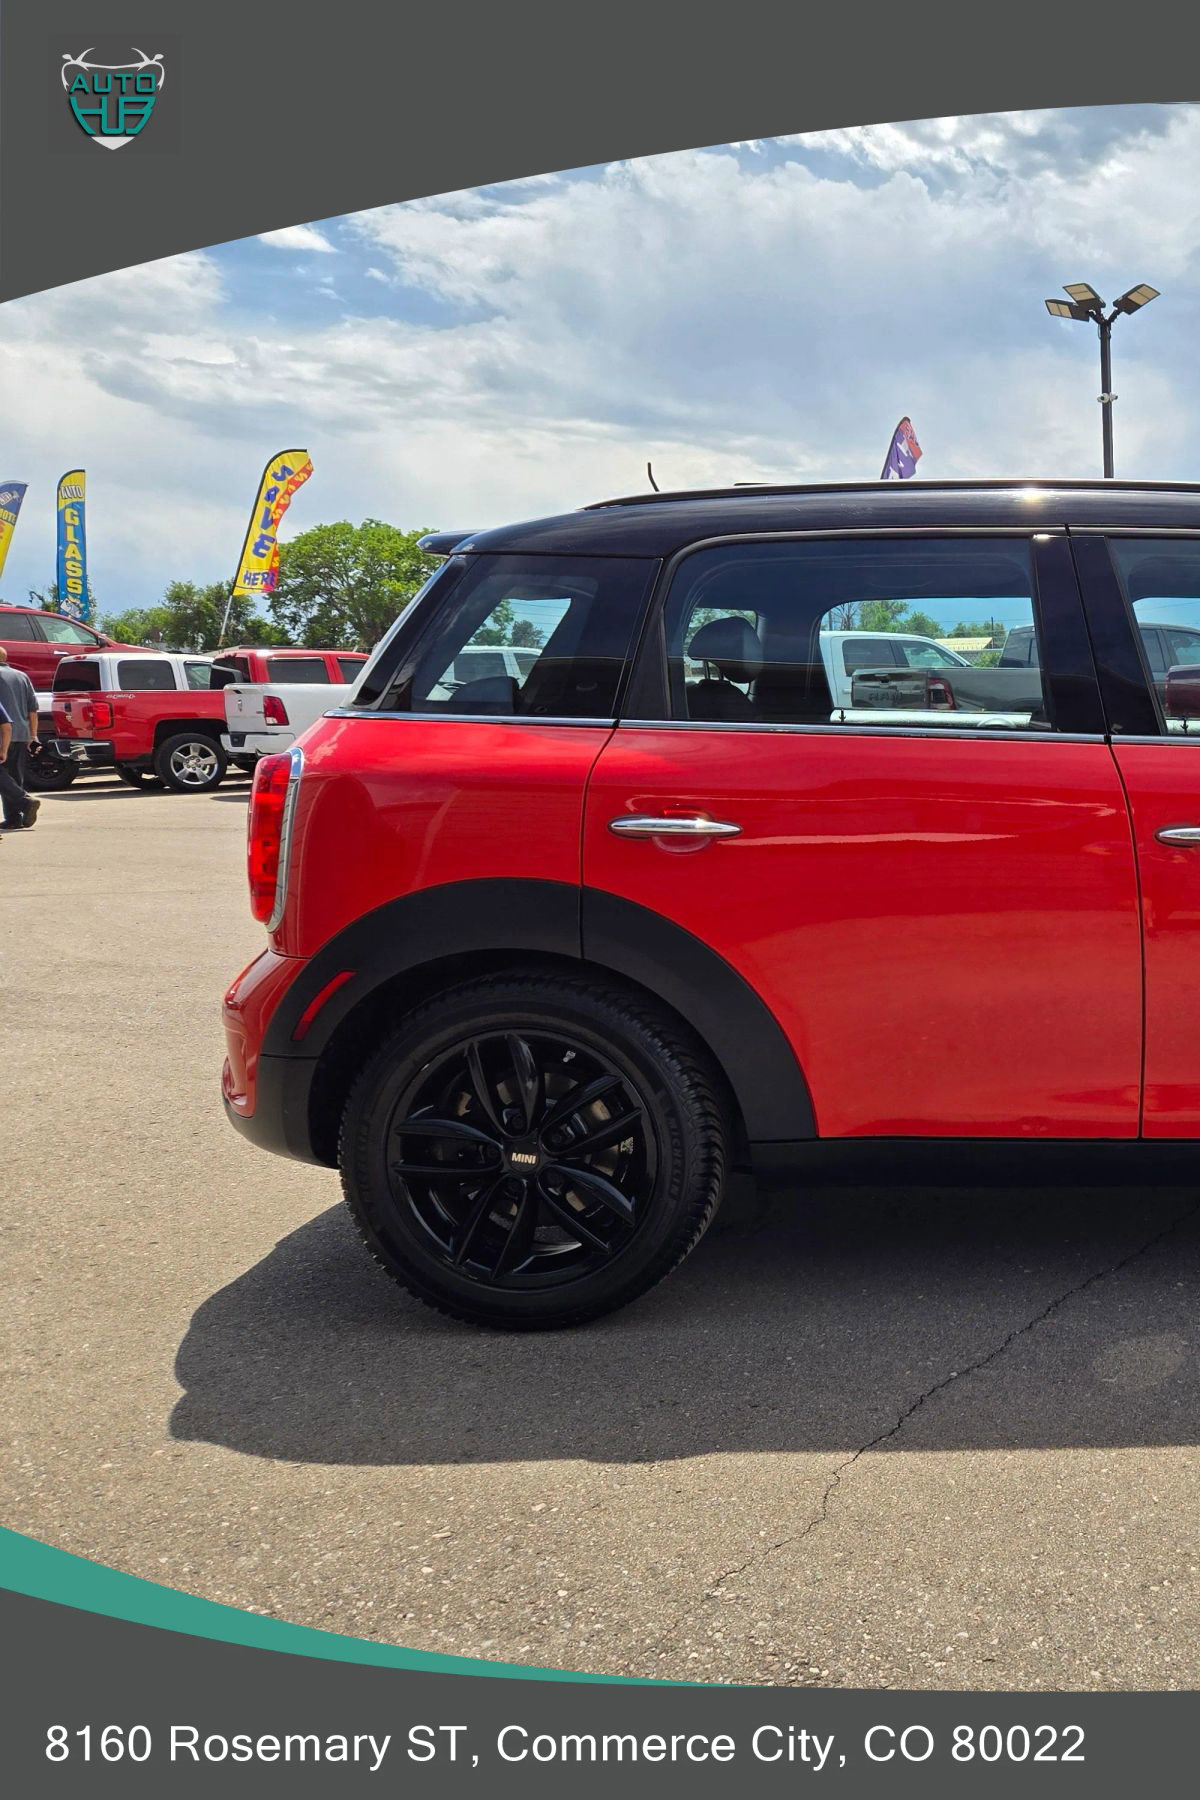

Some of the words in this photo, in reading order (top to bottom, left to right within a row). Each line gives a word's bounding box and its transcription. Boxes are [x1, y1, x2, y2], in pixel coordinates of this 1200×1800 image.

[60, 485, 84, 499] AUTO
[64, 507, 83, 595] GLASS
[511, 1152, 537, 1165] MINI
